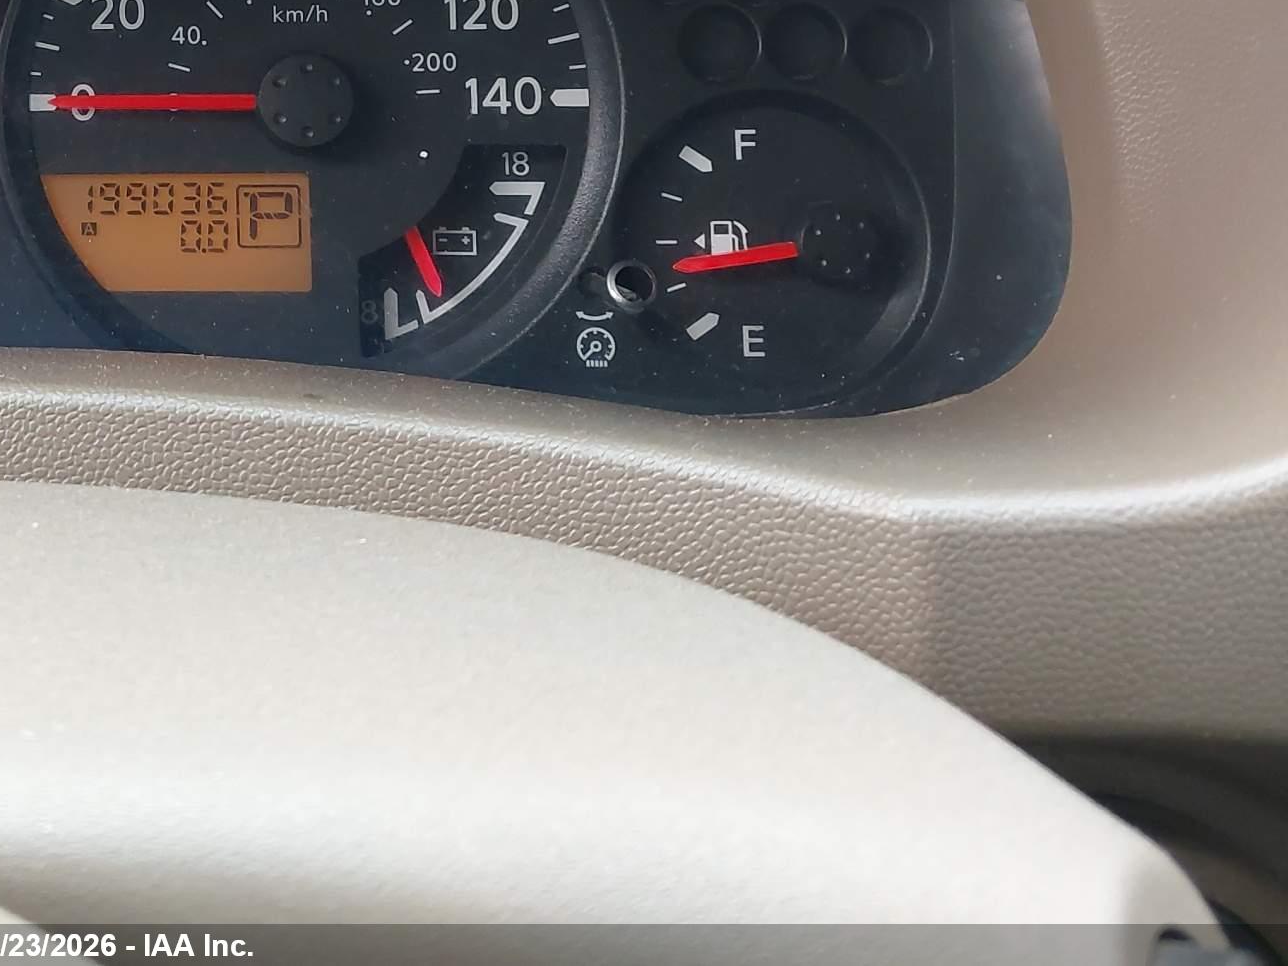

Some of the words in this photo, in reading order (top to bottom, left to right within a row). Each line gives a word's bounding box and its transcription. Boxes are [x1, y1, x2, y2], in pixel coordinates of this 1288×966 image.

[273, 5, 328, 23] km/h
[172, 26, 197, 44] 40
[412, 53, 457, 71] 200
[72, 84, 95, 121] 0
[466, 77, 541, 114] 140
[734, 130, 756, 160] F
[502, 153, 529, 175] 18
[87, 183, 228, 215] 199036
[247, 192, 293, 240] P
[180, 220, 229, 253] 0.0
[743, 325, 765, 357] E
